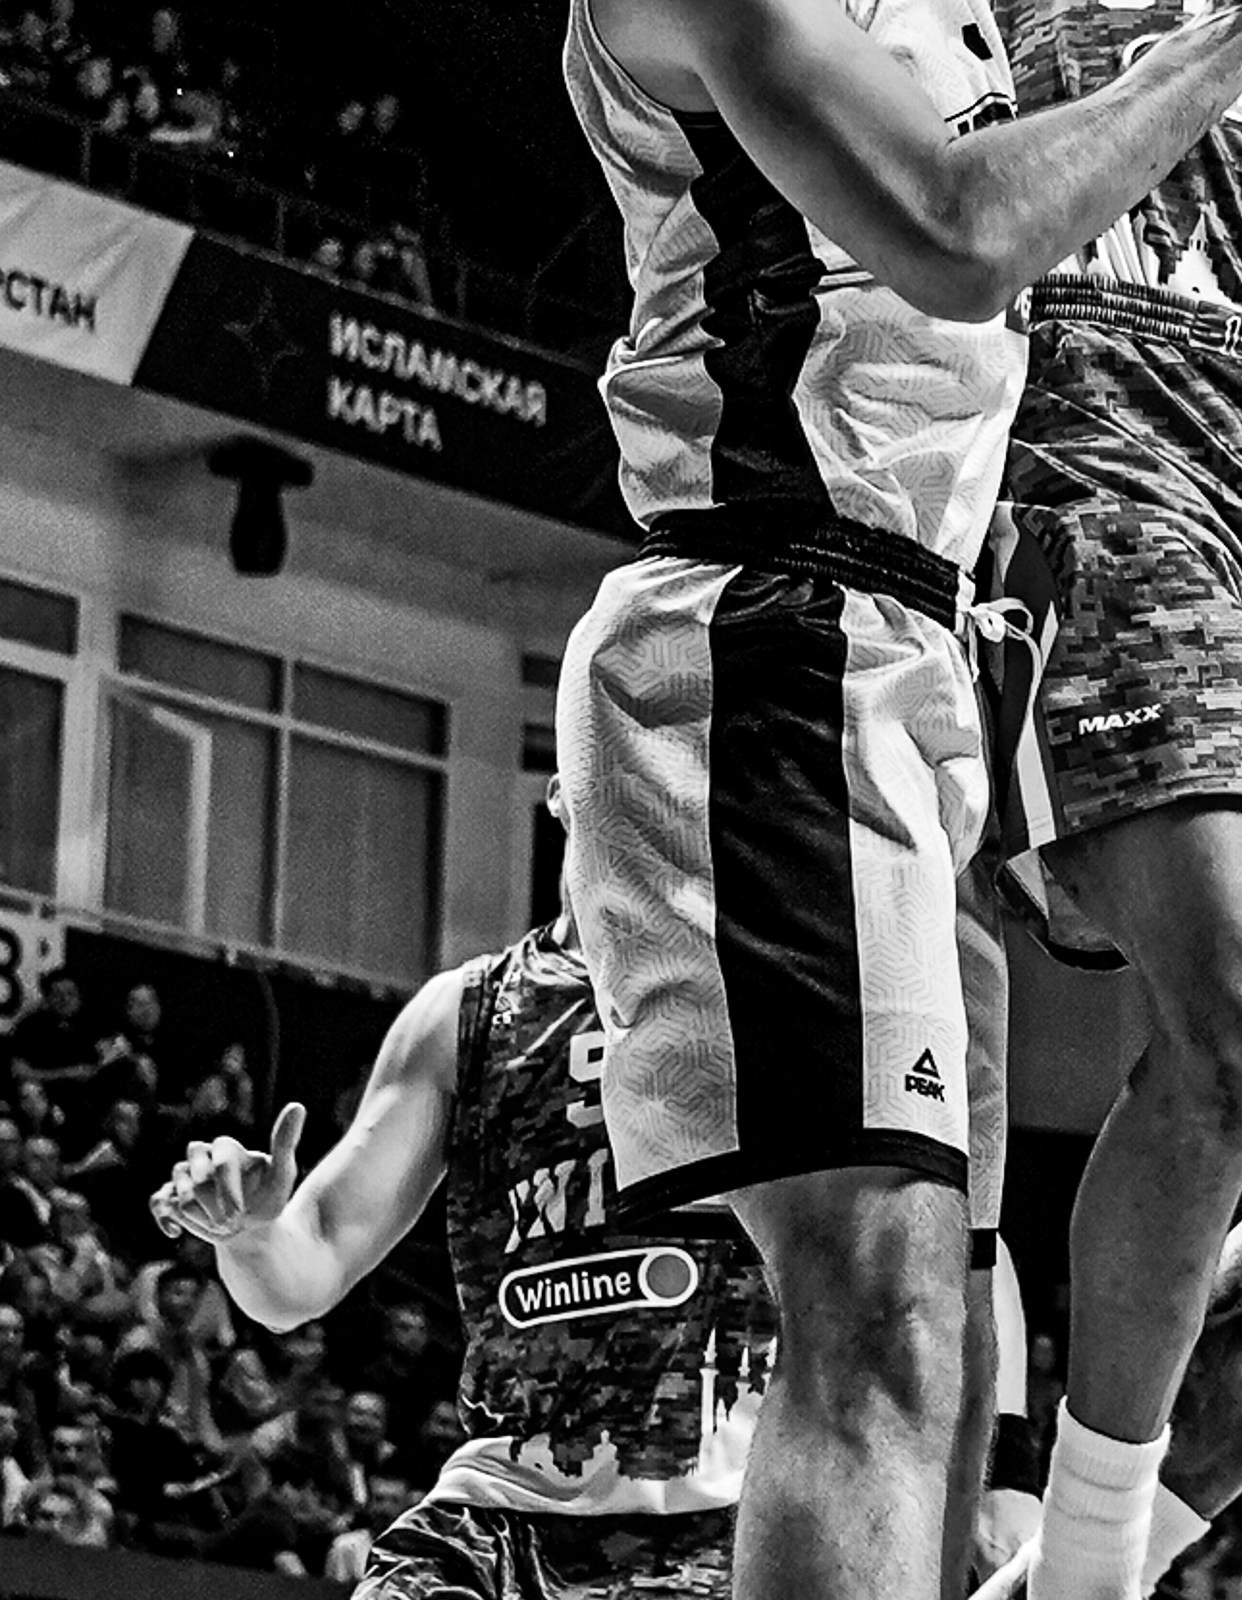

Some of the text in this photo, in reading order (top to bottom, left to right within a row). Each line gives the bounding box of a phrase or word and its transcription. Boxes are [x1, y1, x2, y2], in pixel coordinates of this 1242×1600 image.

[0, 267, 98, 334] СТАН
[328, 311, 547, 427] ИСЛАМСКАЯ
[327, 374, 443, 451] КАРТА
[1078, 703, 1161, 736] MAXX
[515, 1270, 632, 1314] Winline
